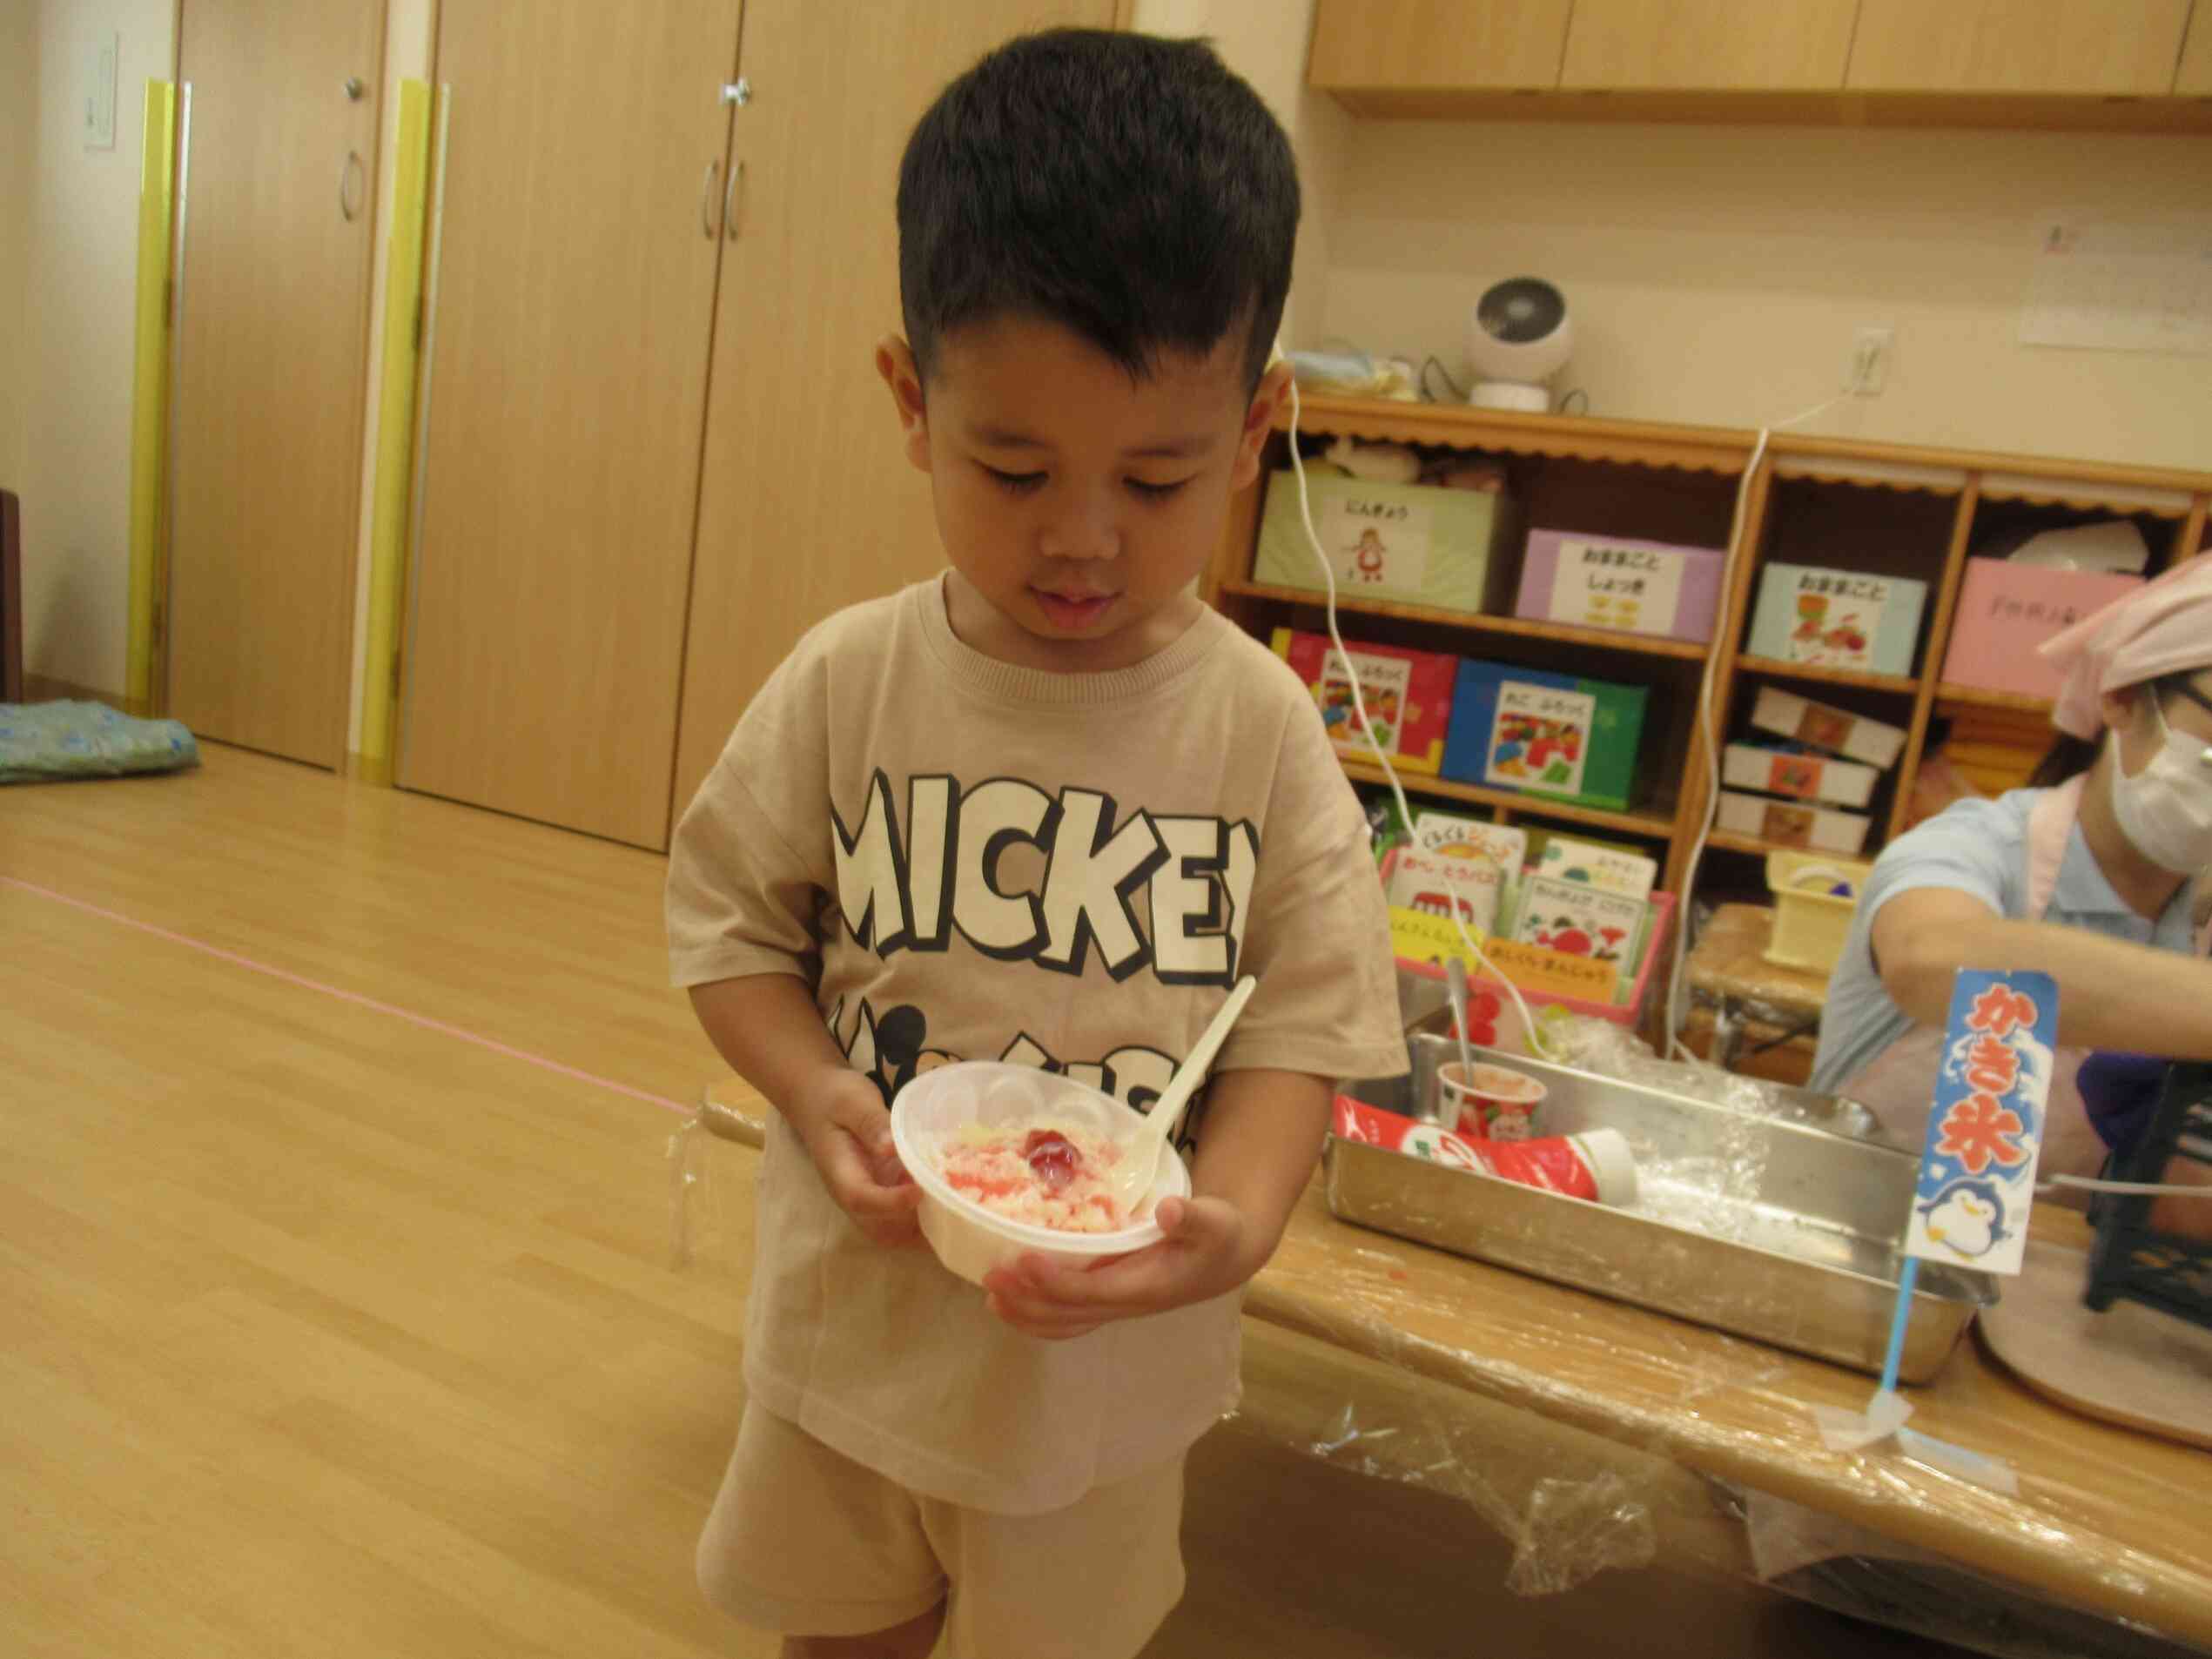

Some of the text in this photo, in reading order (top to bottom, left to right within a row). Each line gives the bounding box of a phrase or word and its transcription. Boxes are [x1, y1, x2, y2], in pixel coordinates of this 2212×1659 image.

[1582, 547, 1660, 573] おままごと
[1798, 571, 1887, 602] おままごと
[1934, 983, 2038, 1174] かき氷
